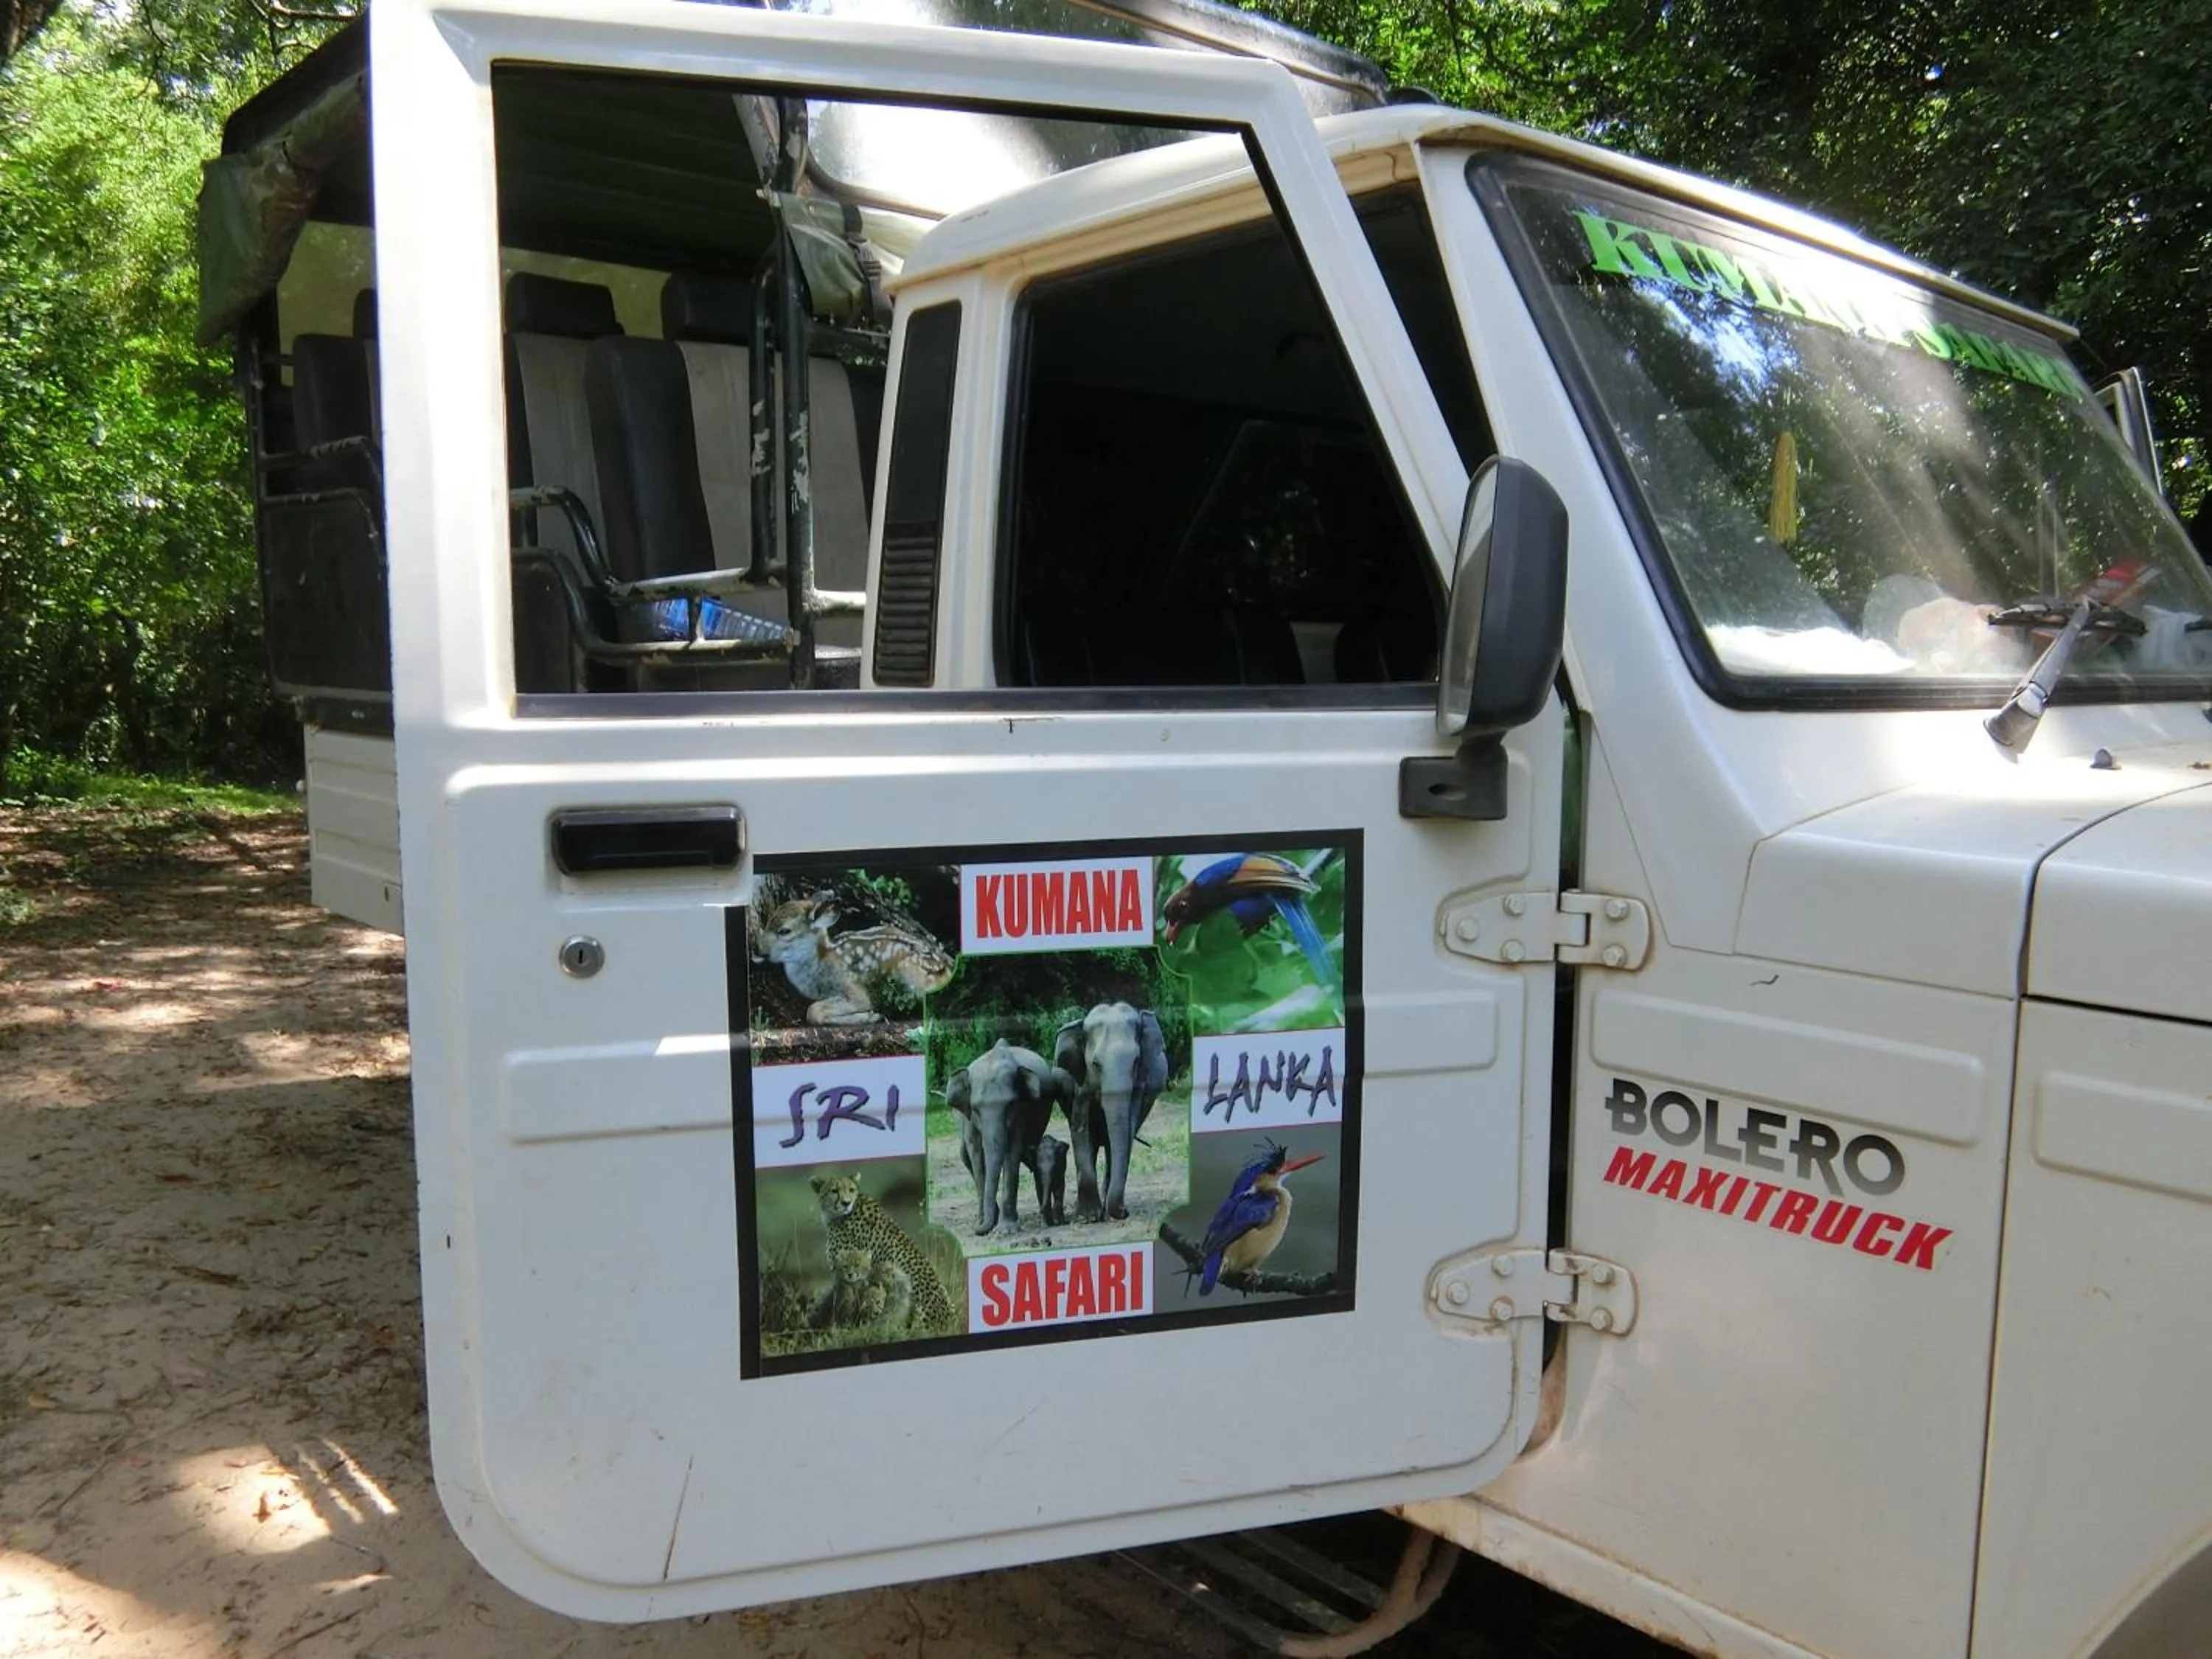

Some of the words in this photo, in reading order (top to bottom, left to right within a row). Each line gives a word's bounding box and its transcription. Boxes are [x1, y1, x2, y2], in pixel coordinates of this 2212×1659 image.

[975, 869, 1143, 939] KUMANA
[779, 1081, 899, 1149] SRI
[1203, 1045, 1338, 1122] LANKA
[1604, 1077, 1906, 1197] BOLERO
[1603, 1146, 1954, 1272] MAXITRUCK
[981, 1251, 1144, 1326] SAFARI
